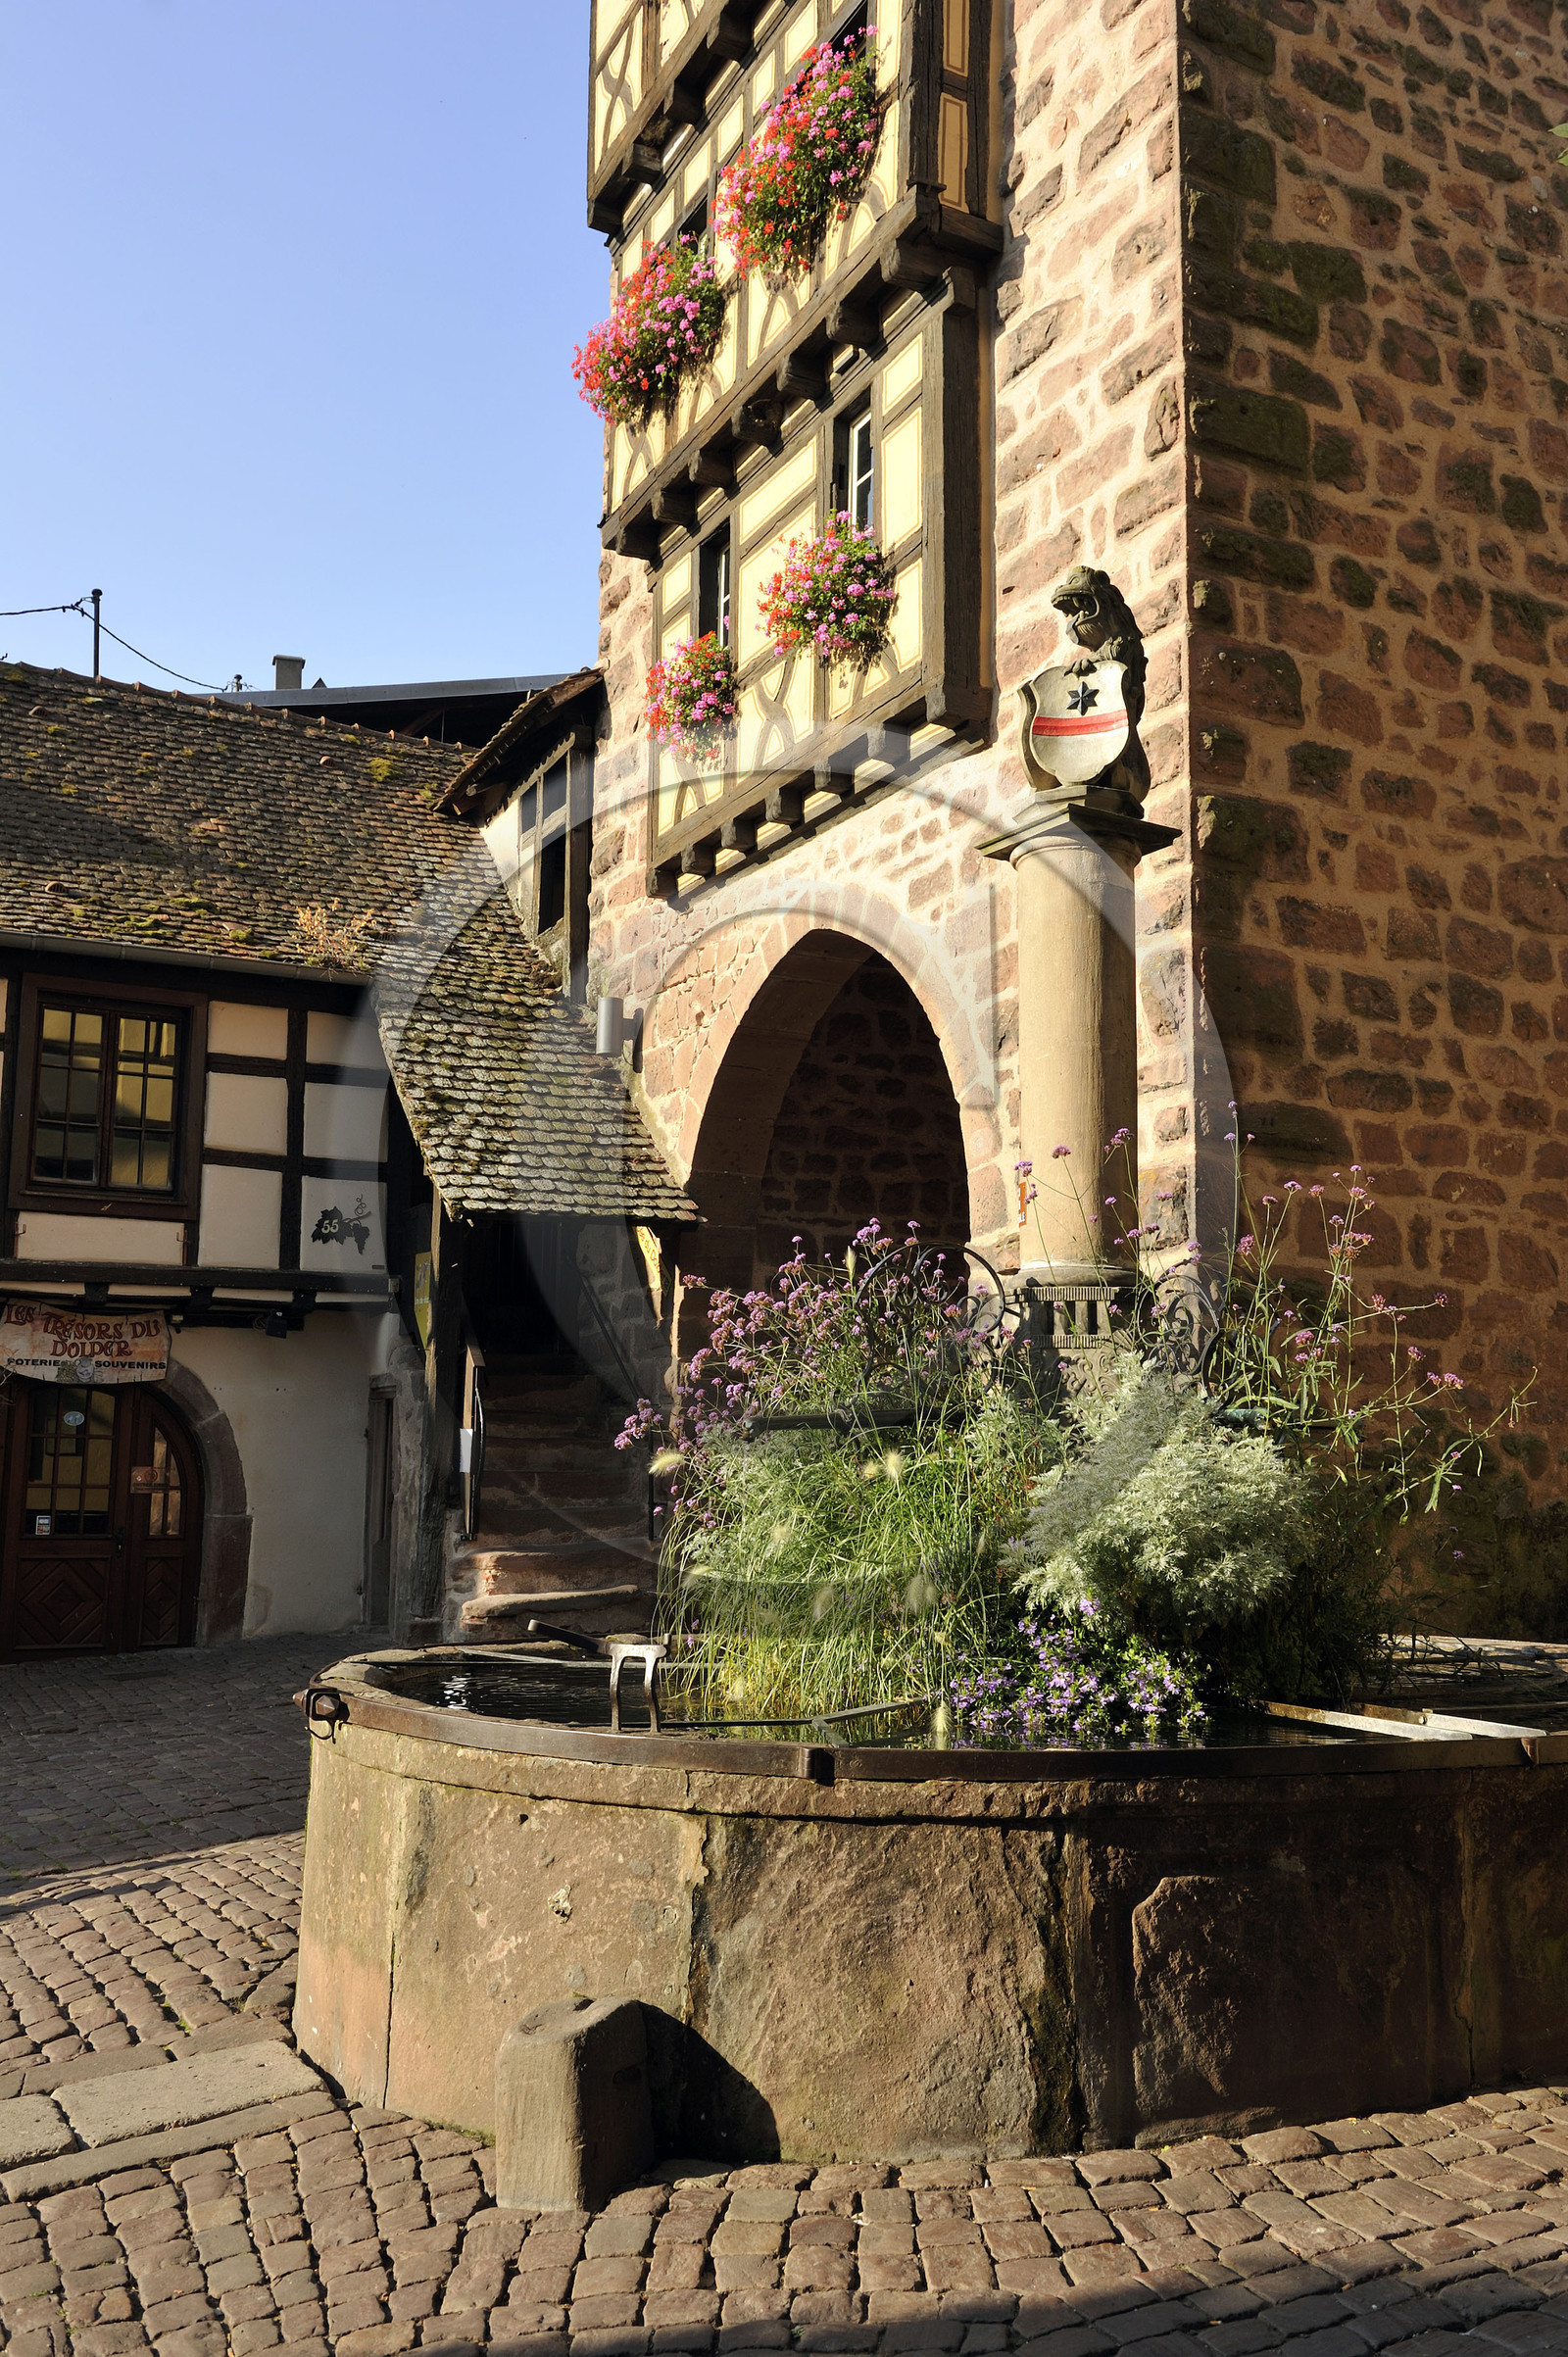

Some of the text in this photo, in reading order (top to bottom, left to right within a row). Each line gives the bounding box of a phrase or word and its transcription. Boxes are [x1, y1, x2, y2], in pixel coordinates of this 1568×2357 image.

[320, 1218, 339, 1234] 55
[130, 1318, 161, 1340] DU
[7, 1357, 61, 1367] POTERIE
[95, 1360, 167, 1370] SOUVENIRS
